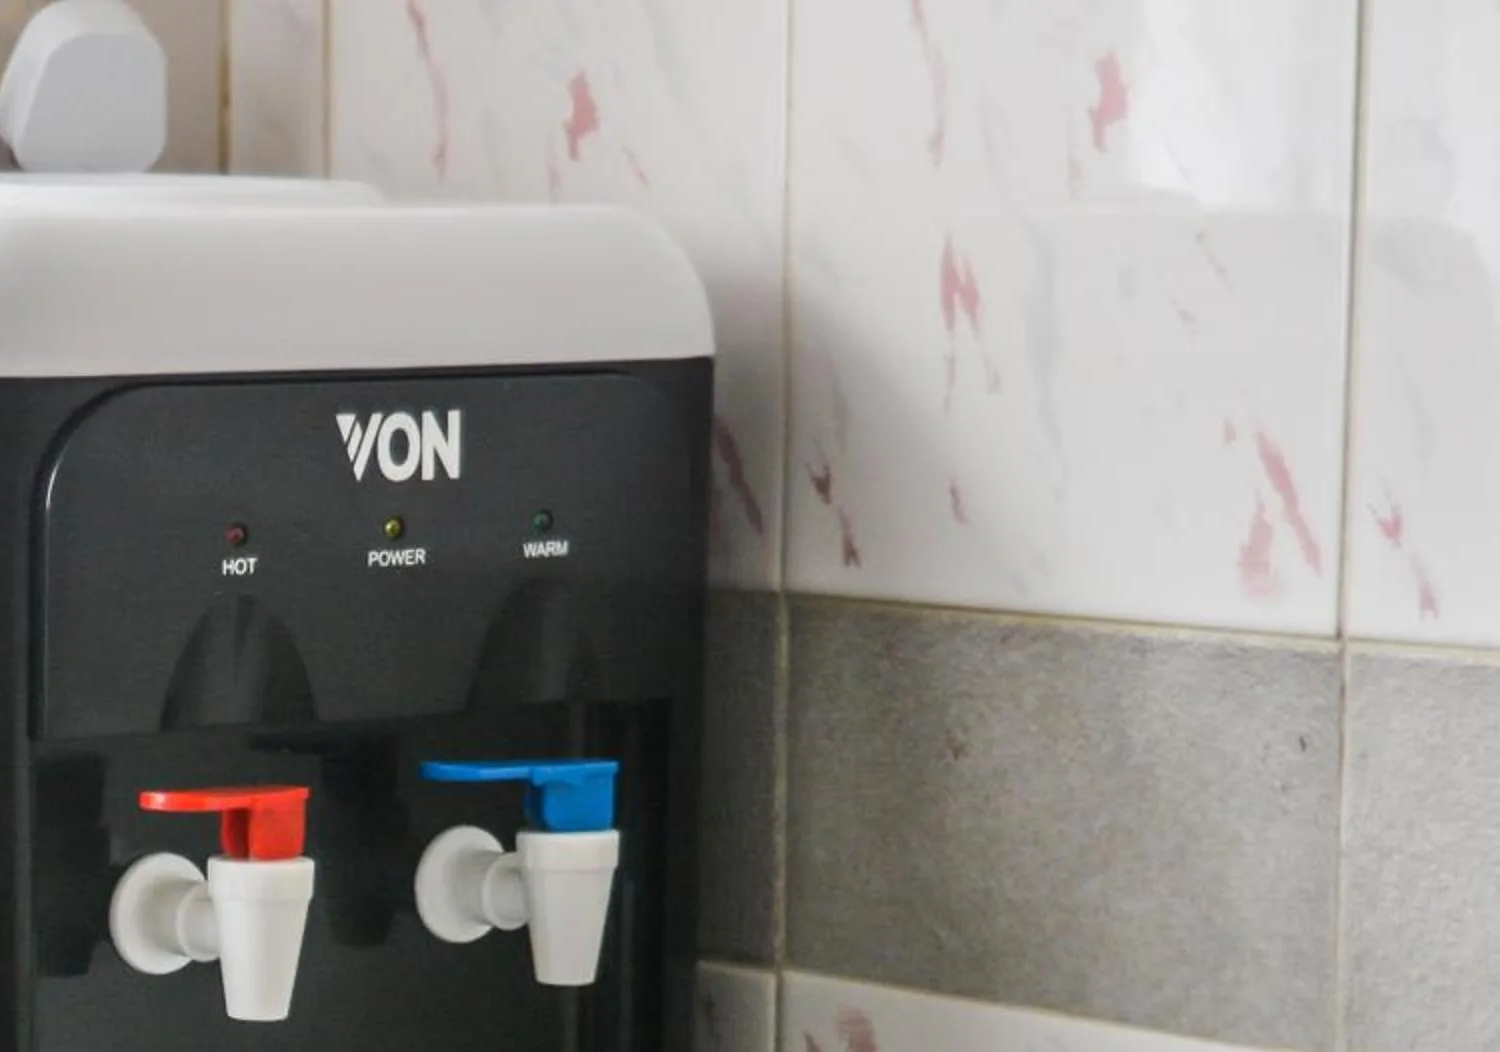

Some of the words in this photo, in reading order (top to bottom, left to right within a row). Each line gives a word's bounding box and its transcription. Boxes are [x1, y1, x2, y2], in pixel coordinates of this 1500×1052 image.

[335, 409, 461, 482] VON
[367, 547, 427, 567] POWER
[522, 540, 569, 558] WARM
[221, 556, 258, 576] HOT
